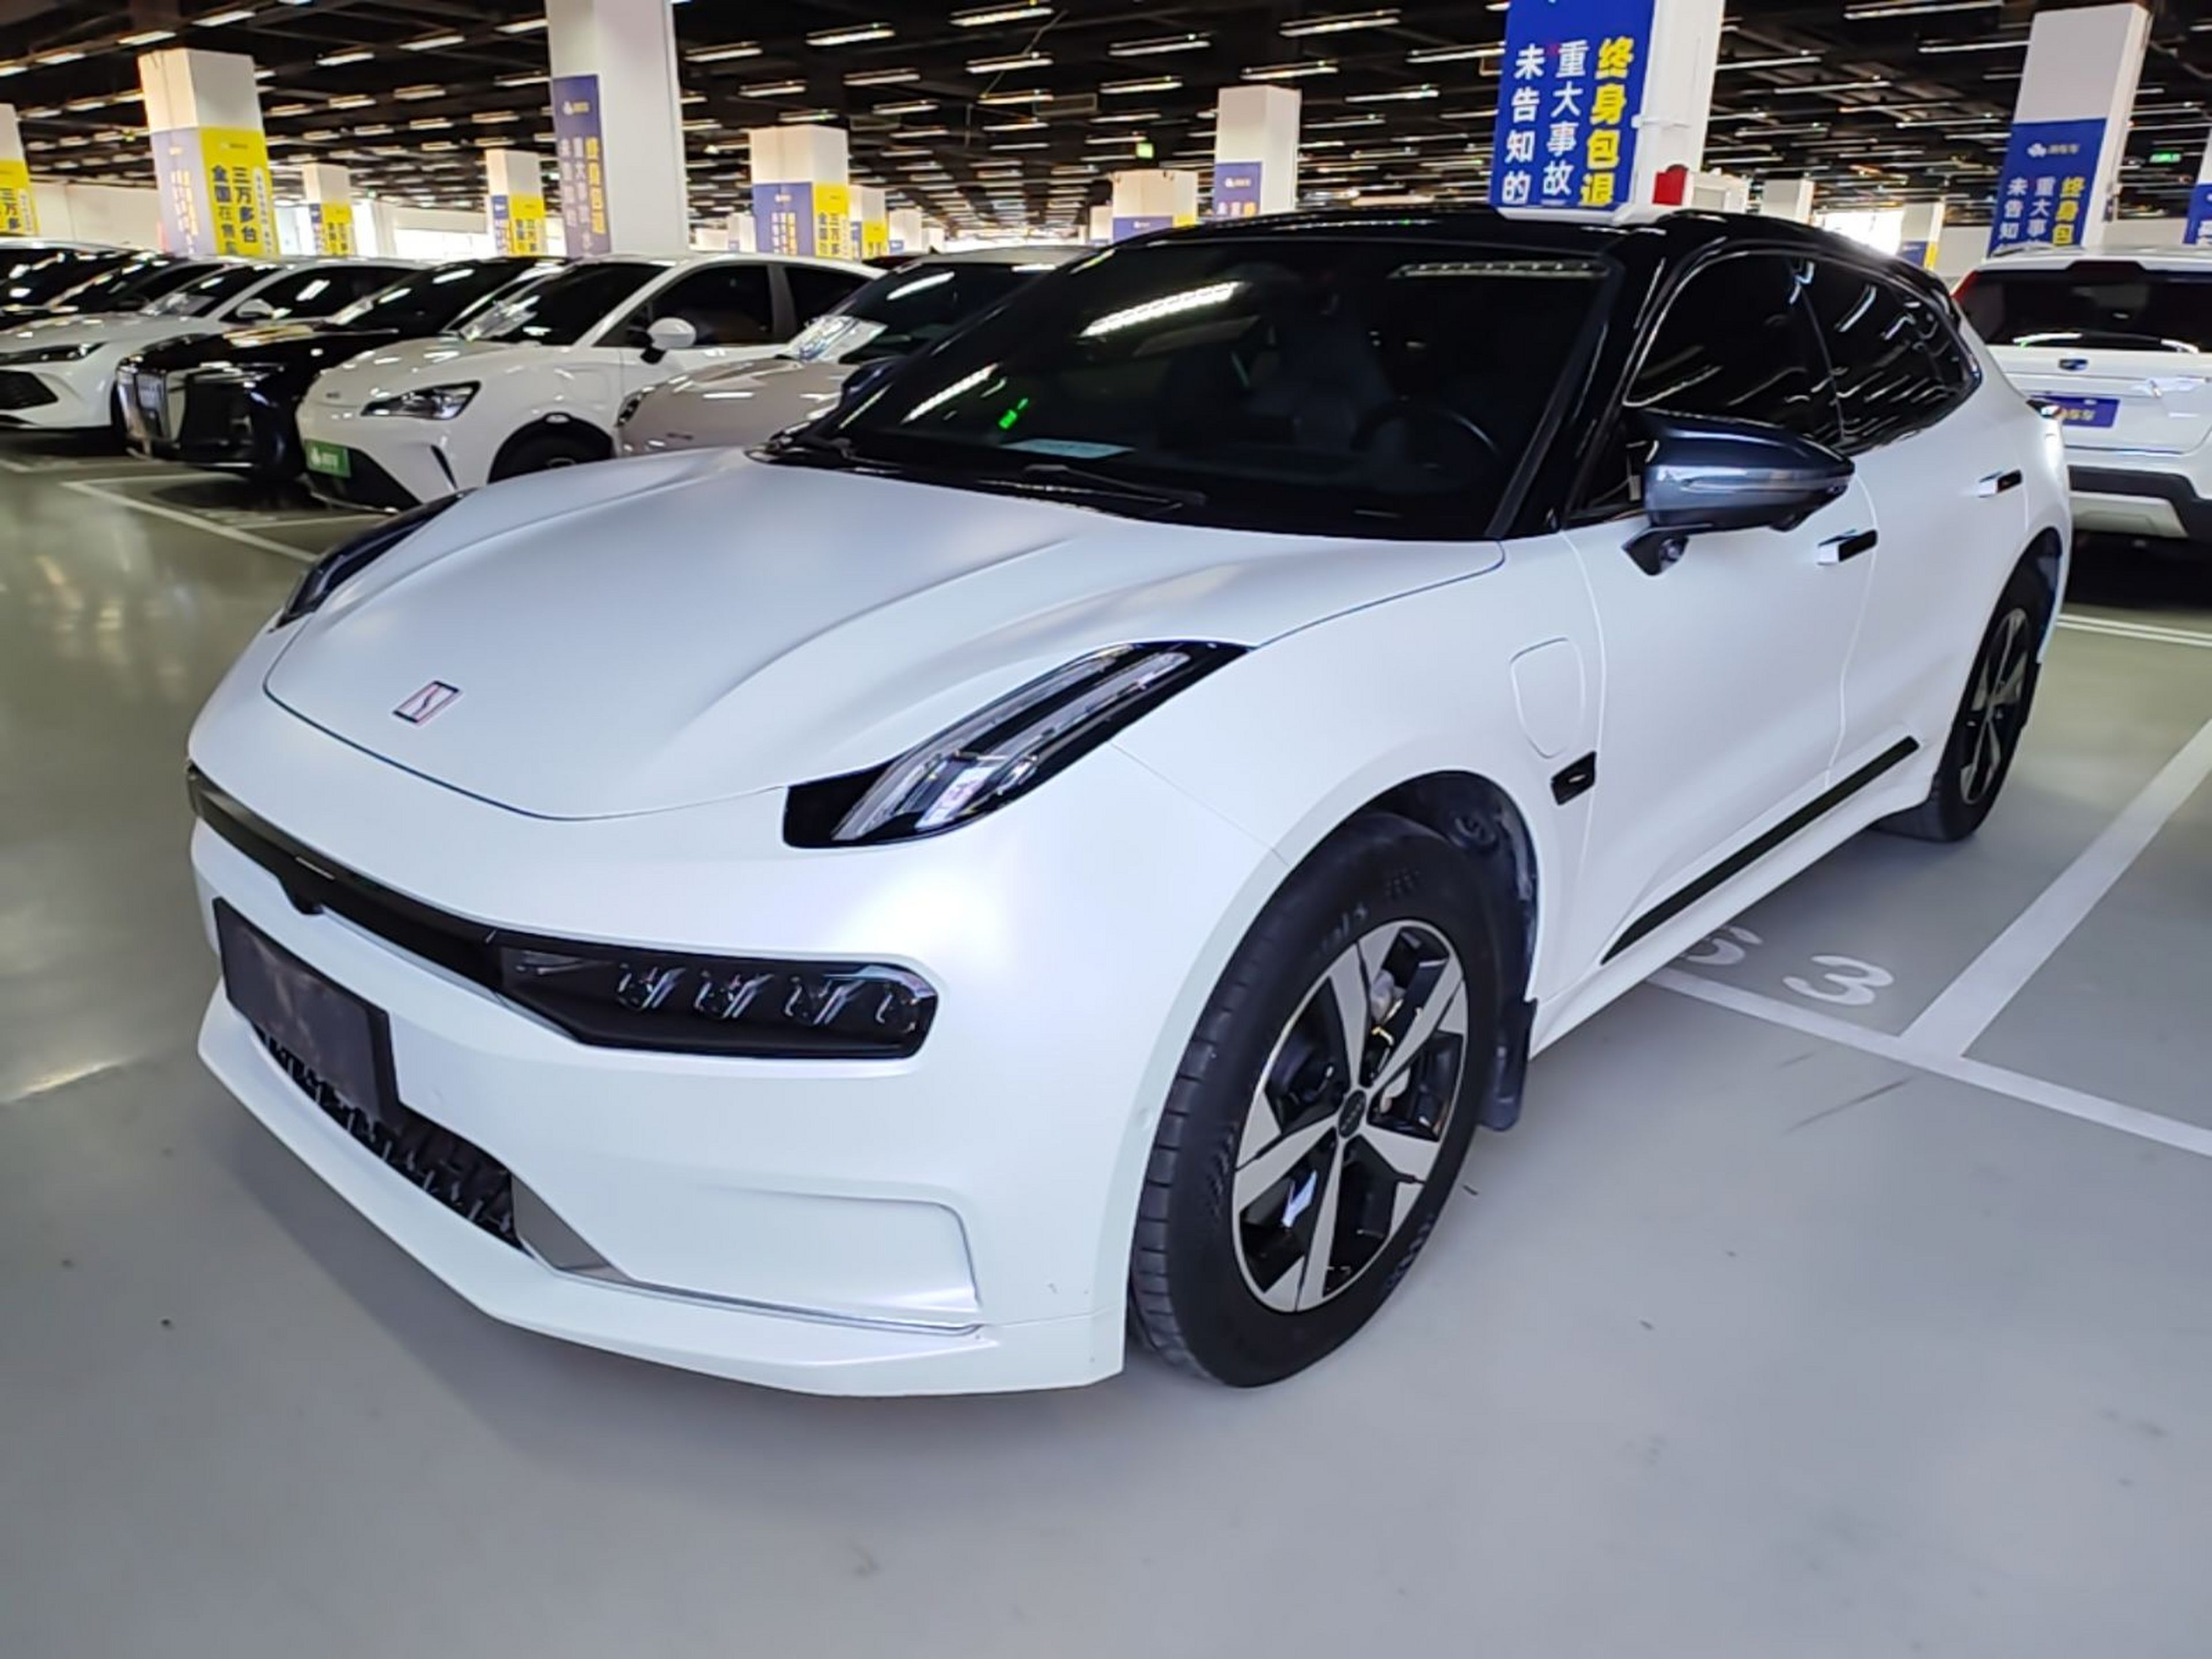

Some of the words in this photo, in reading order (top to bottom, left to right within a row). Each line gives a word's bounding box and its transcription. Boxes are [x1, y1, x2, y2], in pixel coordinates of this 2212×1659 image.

[1502, 44, 1545, 204] 未告知的
[1541, 40, 1589, 206] 重大事故
[1578, 36, 1635, 206] 终身包退
[232, 166, 257, 243] 三万多台
[1998, 176, 2029, 245] 未告知
[2027, 176, 2056, 243] 重大事
